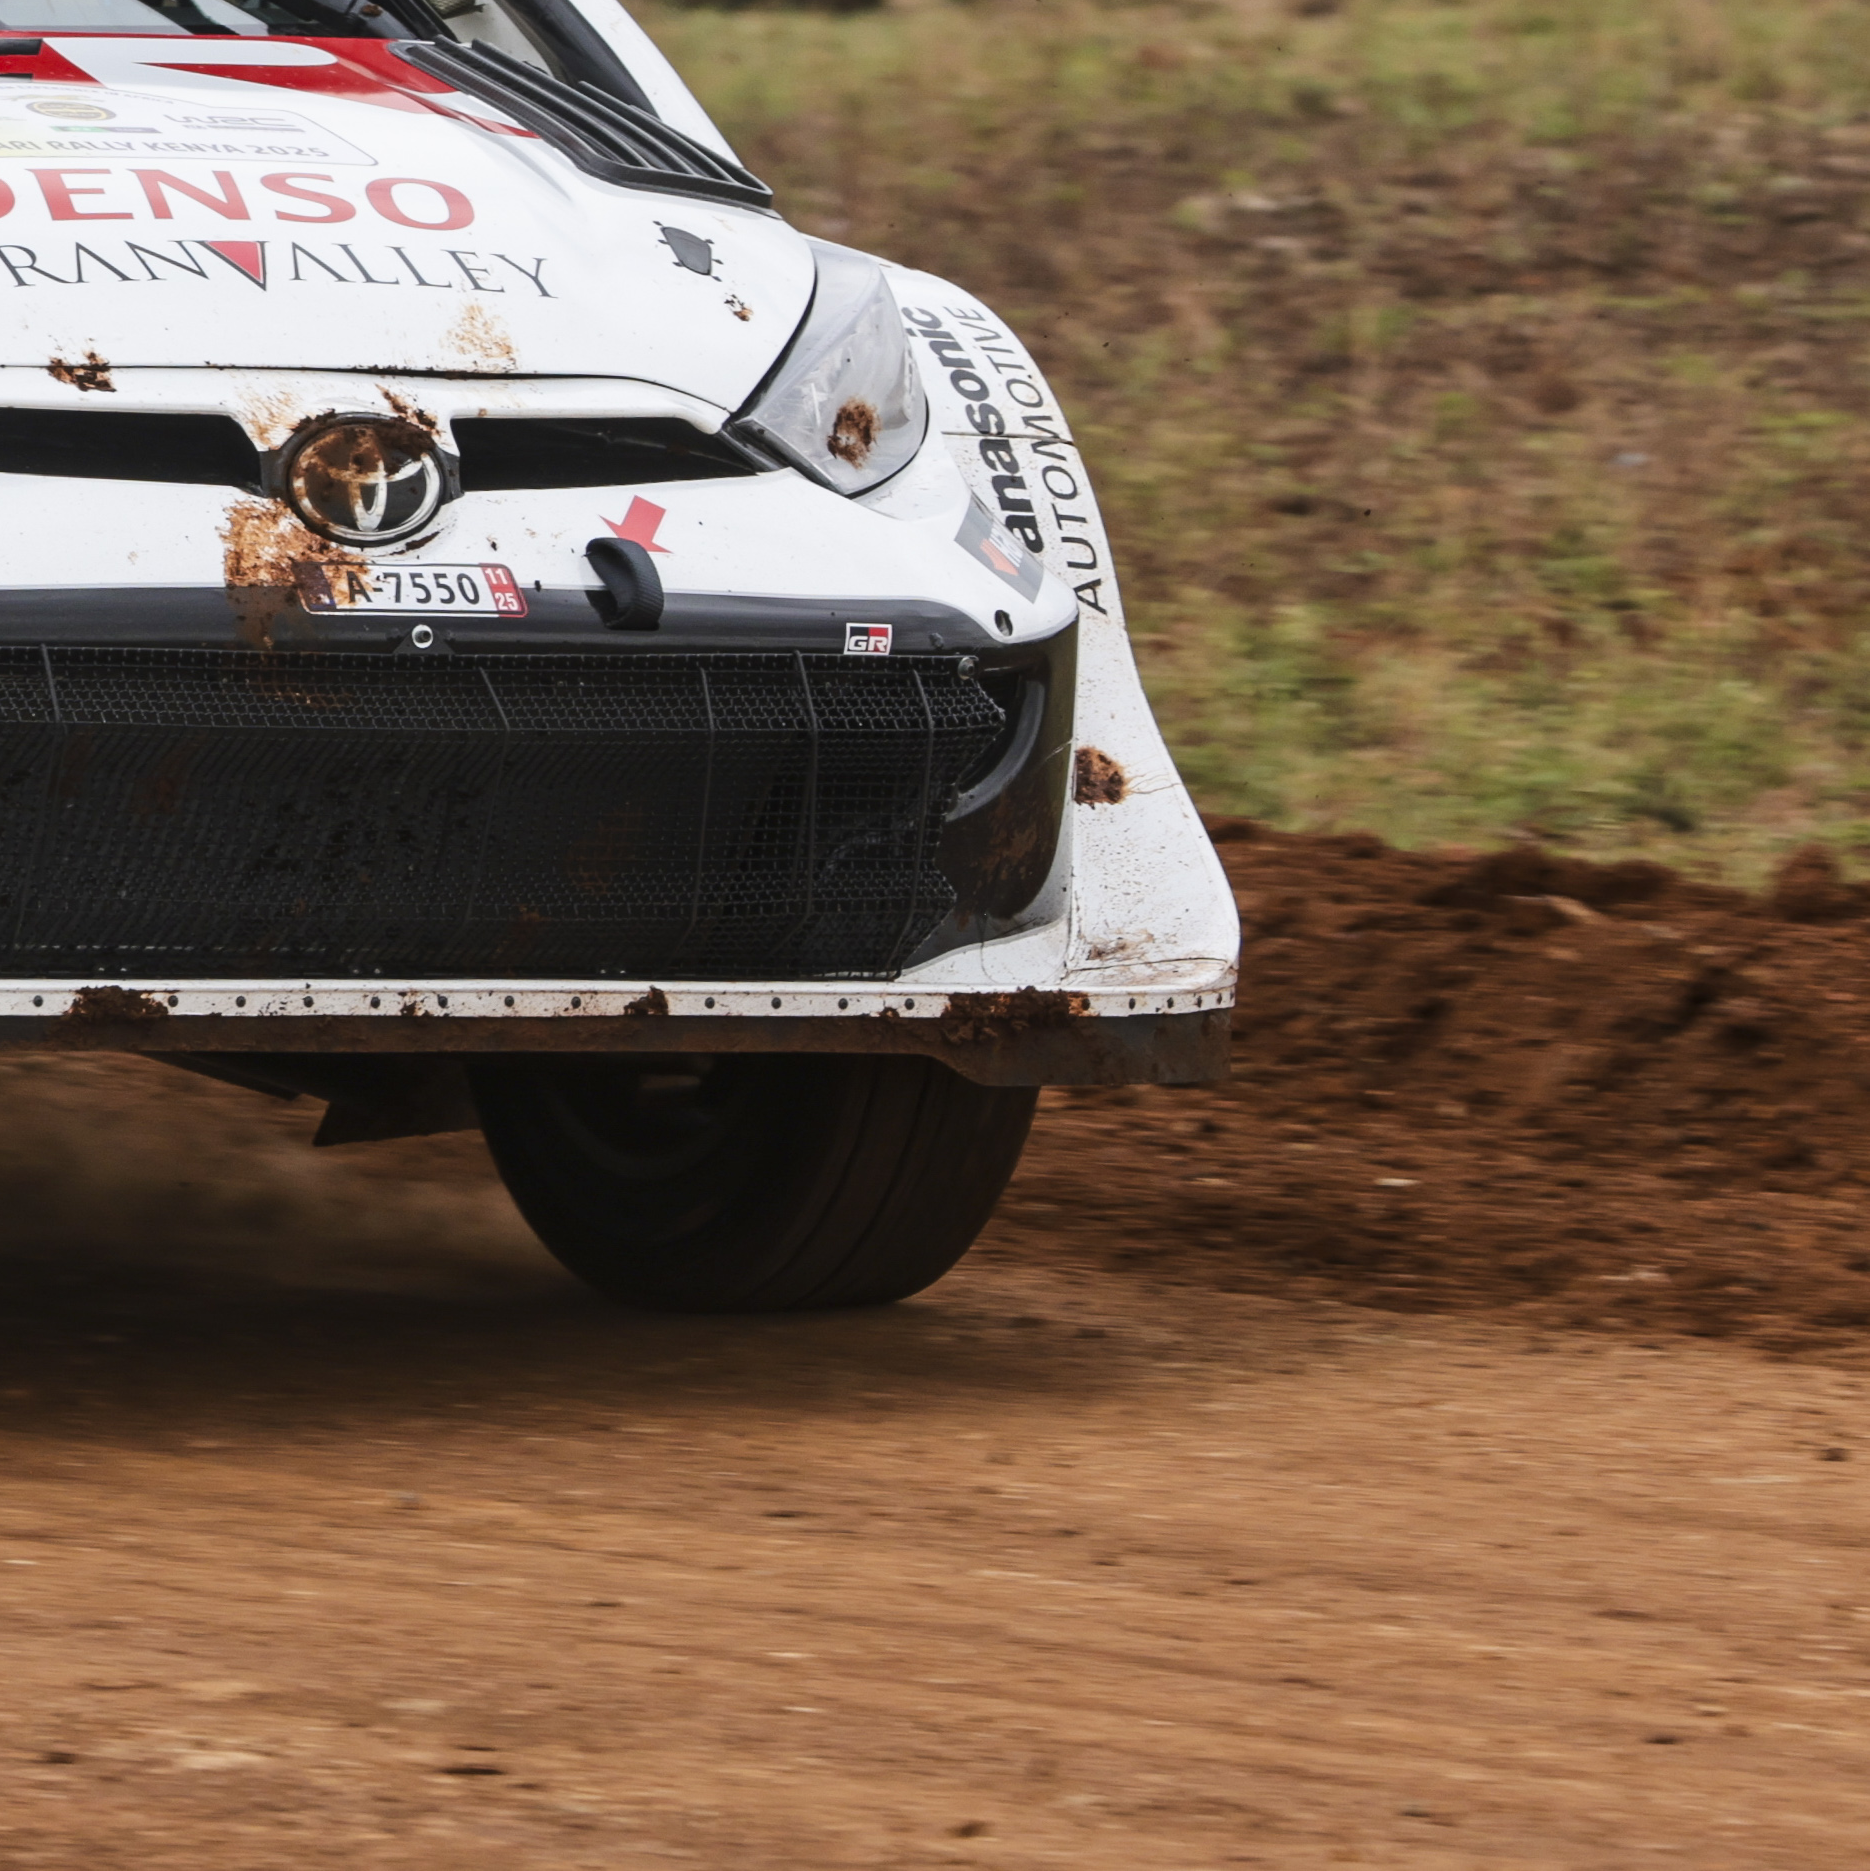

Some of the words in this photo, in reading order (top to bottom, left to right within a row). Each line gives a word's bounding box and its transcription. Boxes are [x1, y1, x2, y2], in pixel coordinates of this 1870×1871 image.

[46, 140, 136, 153] RALLY
[143, 141, 246, 155] KENYA
[246, 144, 330, 158] 2025
[901, 307, 1044, 555] anasonic
[943, 304, 1108, 616] AUTOMOTIVE
[484, 568, 509, 586] 11
[346, 570, 481, 606] A-7550
[494, 592, 519, 611] 25
[847, 633, 891, 654] GR
